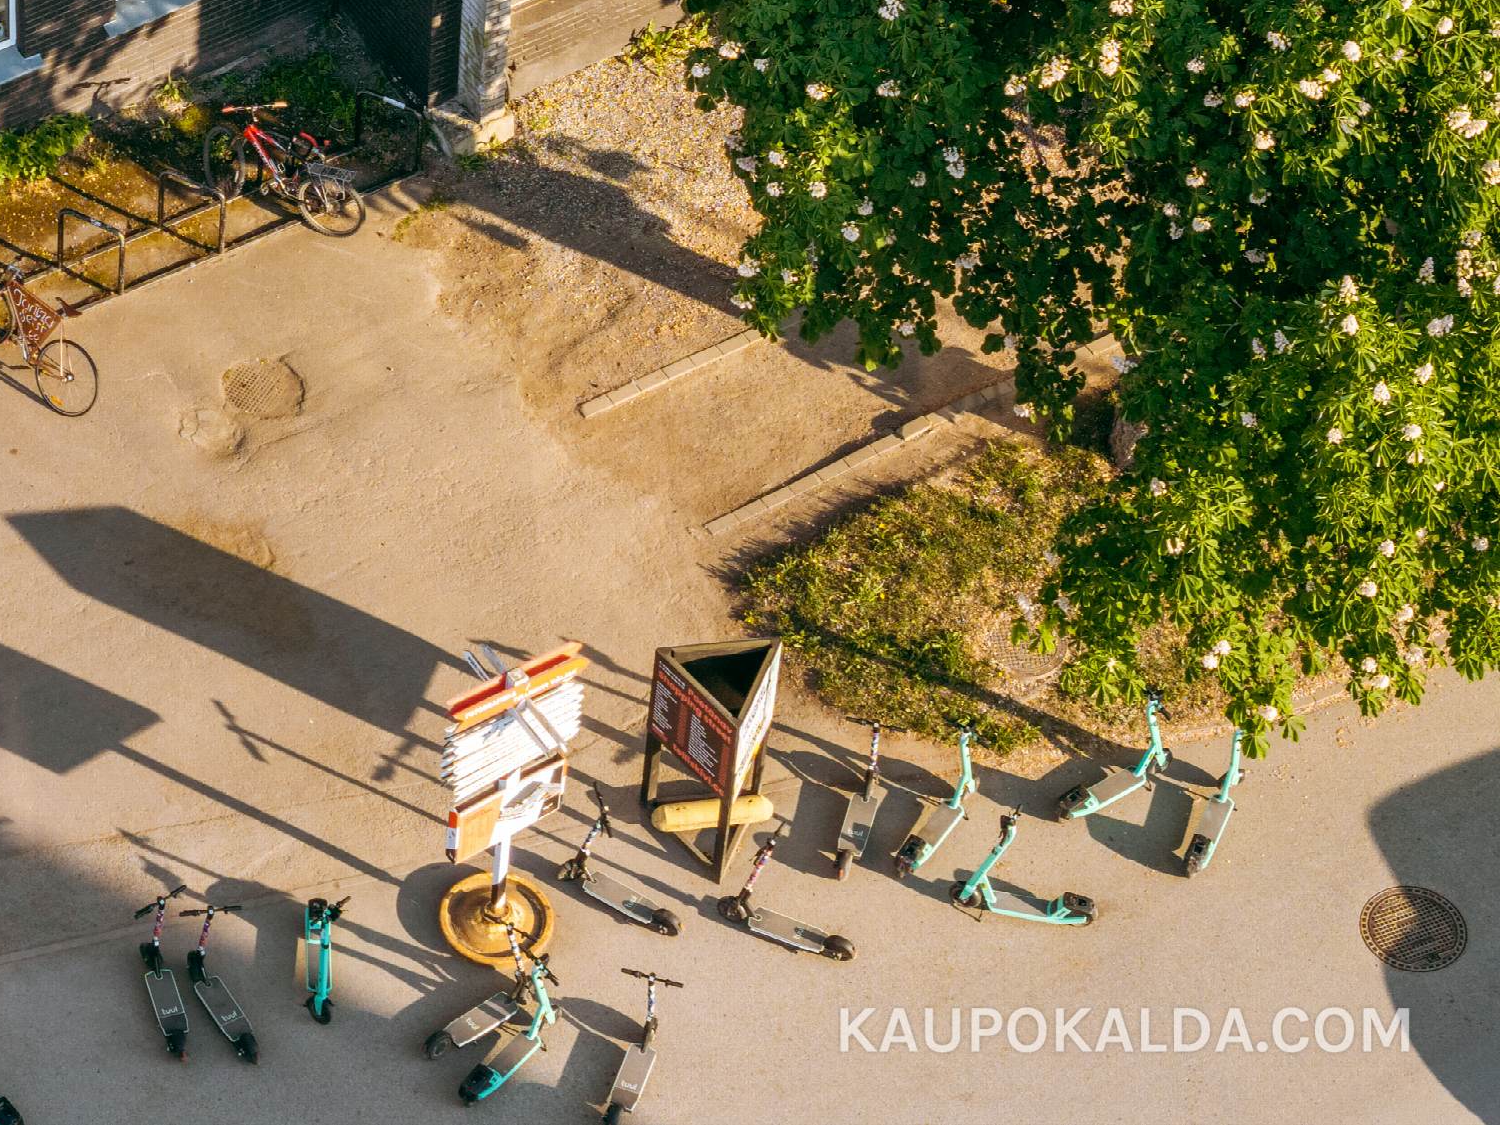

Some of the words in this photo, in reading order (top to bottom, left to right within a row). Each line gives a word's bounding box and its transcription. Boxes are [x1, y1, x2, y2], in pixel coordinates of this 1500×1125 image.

[161, 1005, 179, 1016] tuul
[221, 1010, 238, 1023] tuul
[620, 1079, 639, 1092] tuul
